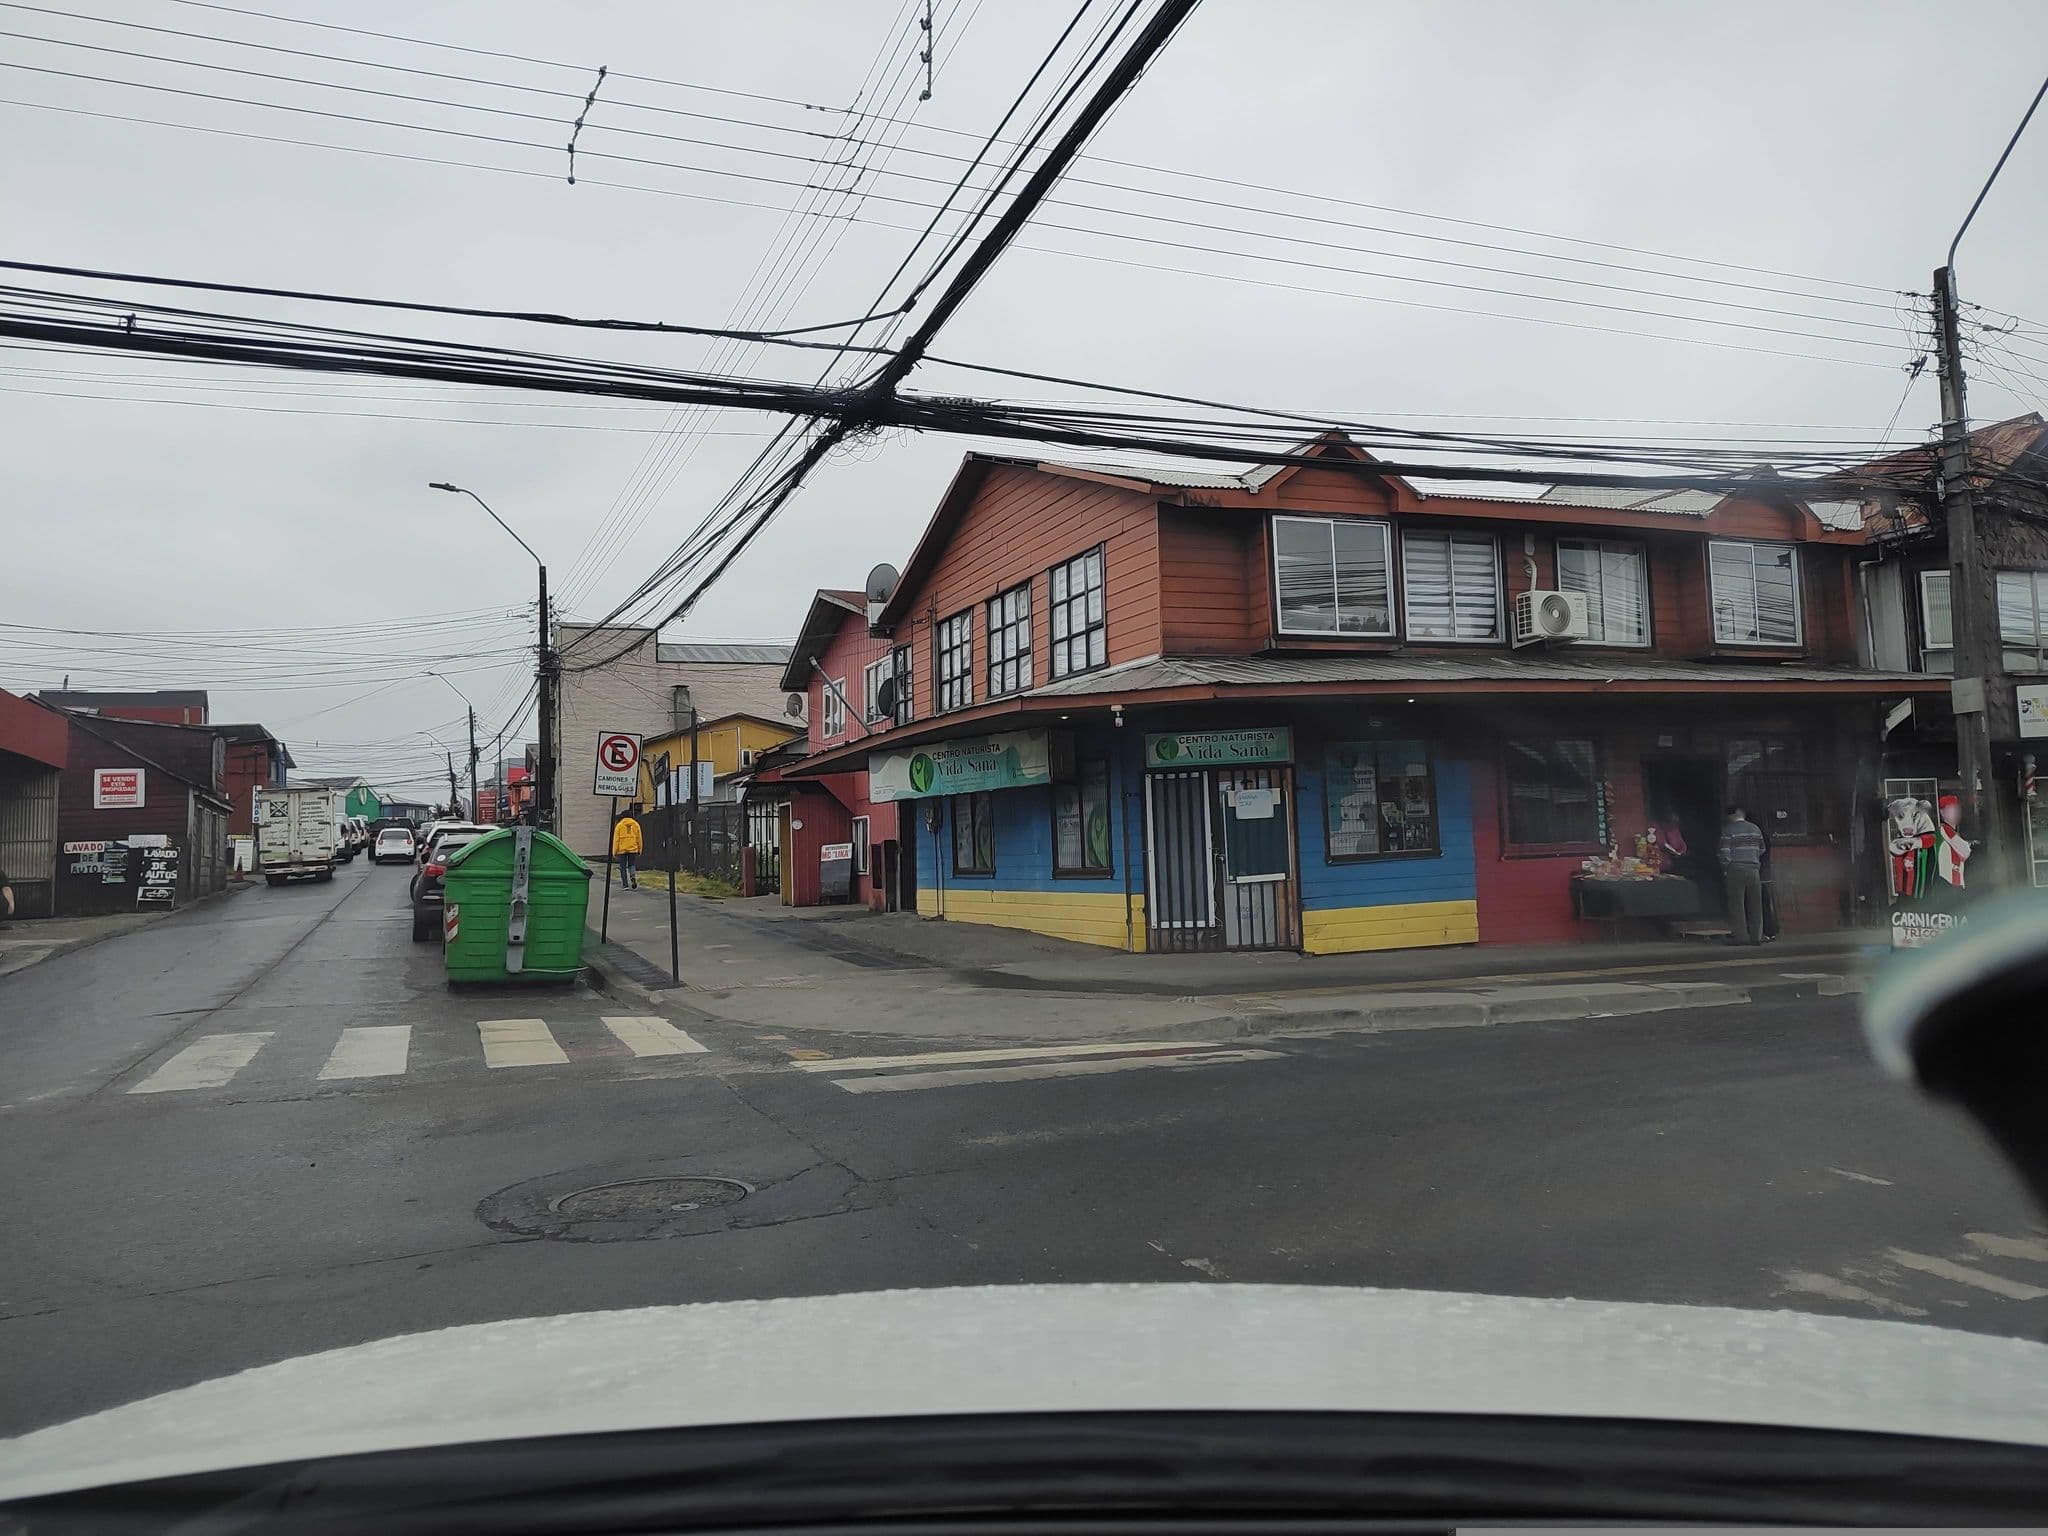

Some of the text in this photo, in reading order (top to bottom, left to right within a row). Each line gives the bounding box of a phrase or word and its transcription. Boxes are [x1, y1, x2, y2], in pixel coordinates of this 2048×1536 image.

[1179, 732, 1275, 745] CENTRO NATURISTA
[932, 743, 1001, 761] CENTRO NATURISTA
[1185, 743, 1269, 759] Vida Sana
[937, 757, 997, 777] Vida Sana
[598, 775, 628, 783] CAMIONES
[597, 784, 634, 792] REMOLQUES
[65, 843, 103, 853] LAVADO
[144, 848, 178, 858] LAVADO
[82, 853, 95, 862] DE
[151, 861, 167, 870] DE
[145, 870, 178, 879] AUTOS
[1891, 911, 1969, 929] CARNICERIA
